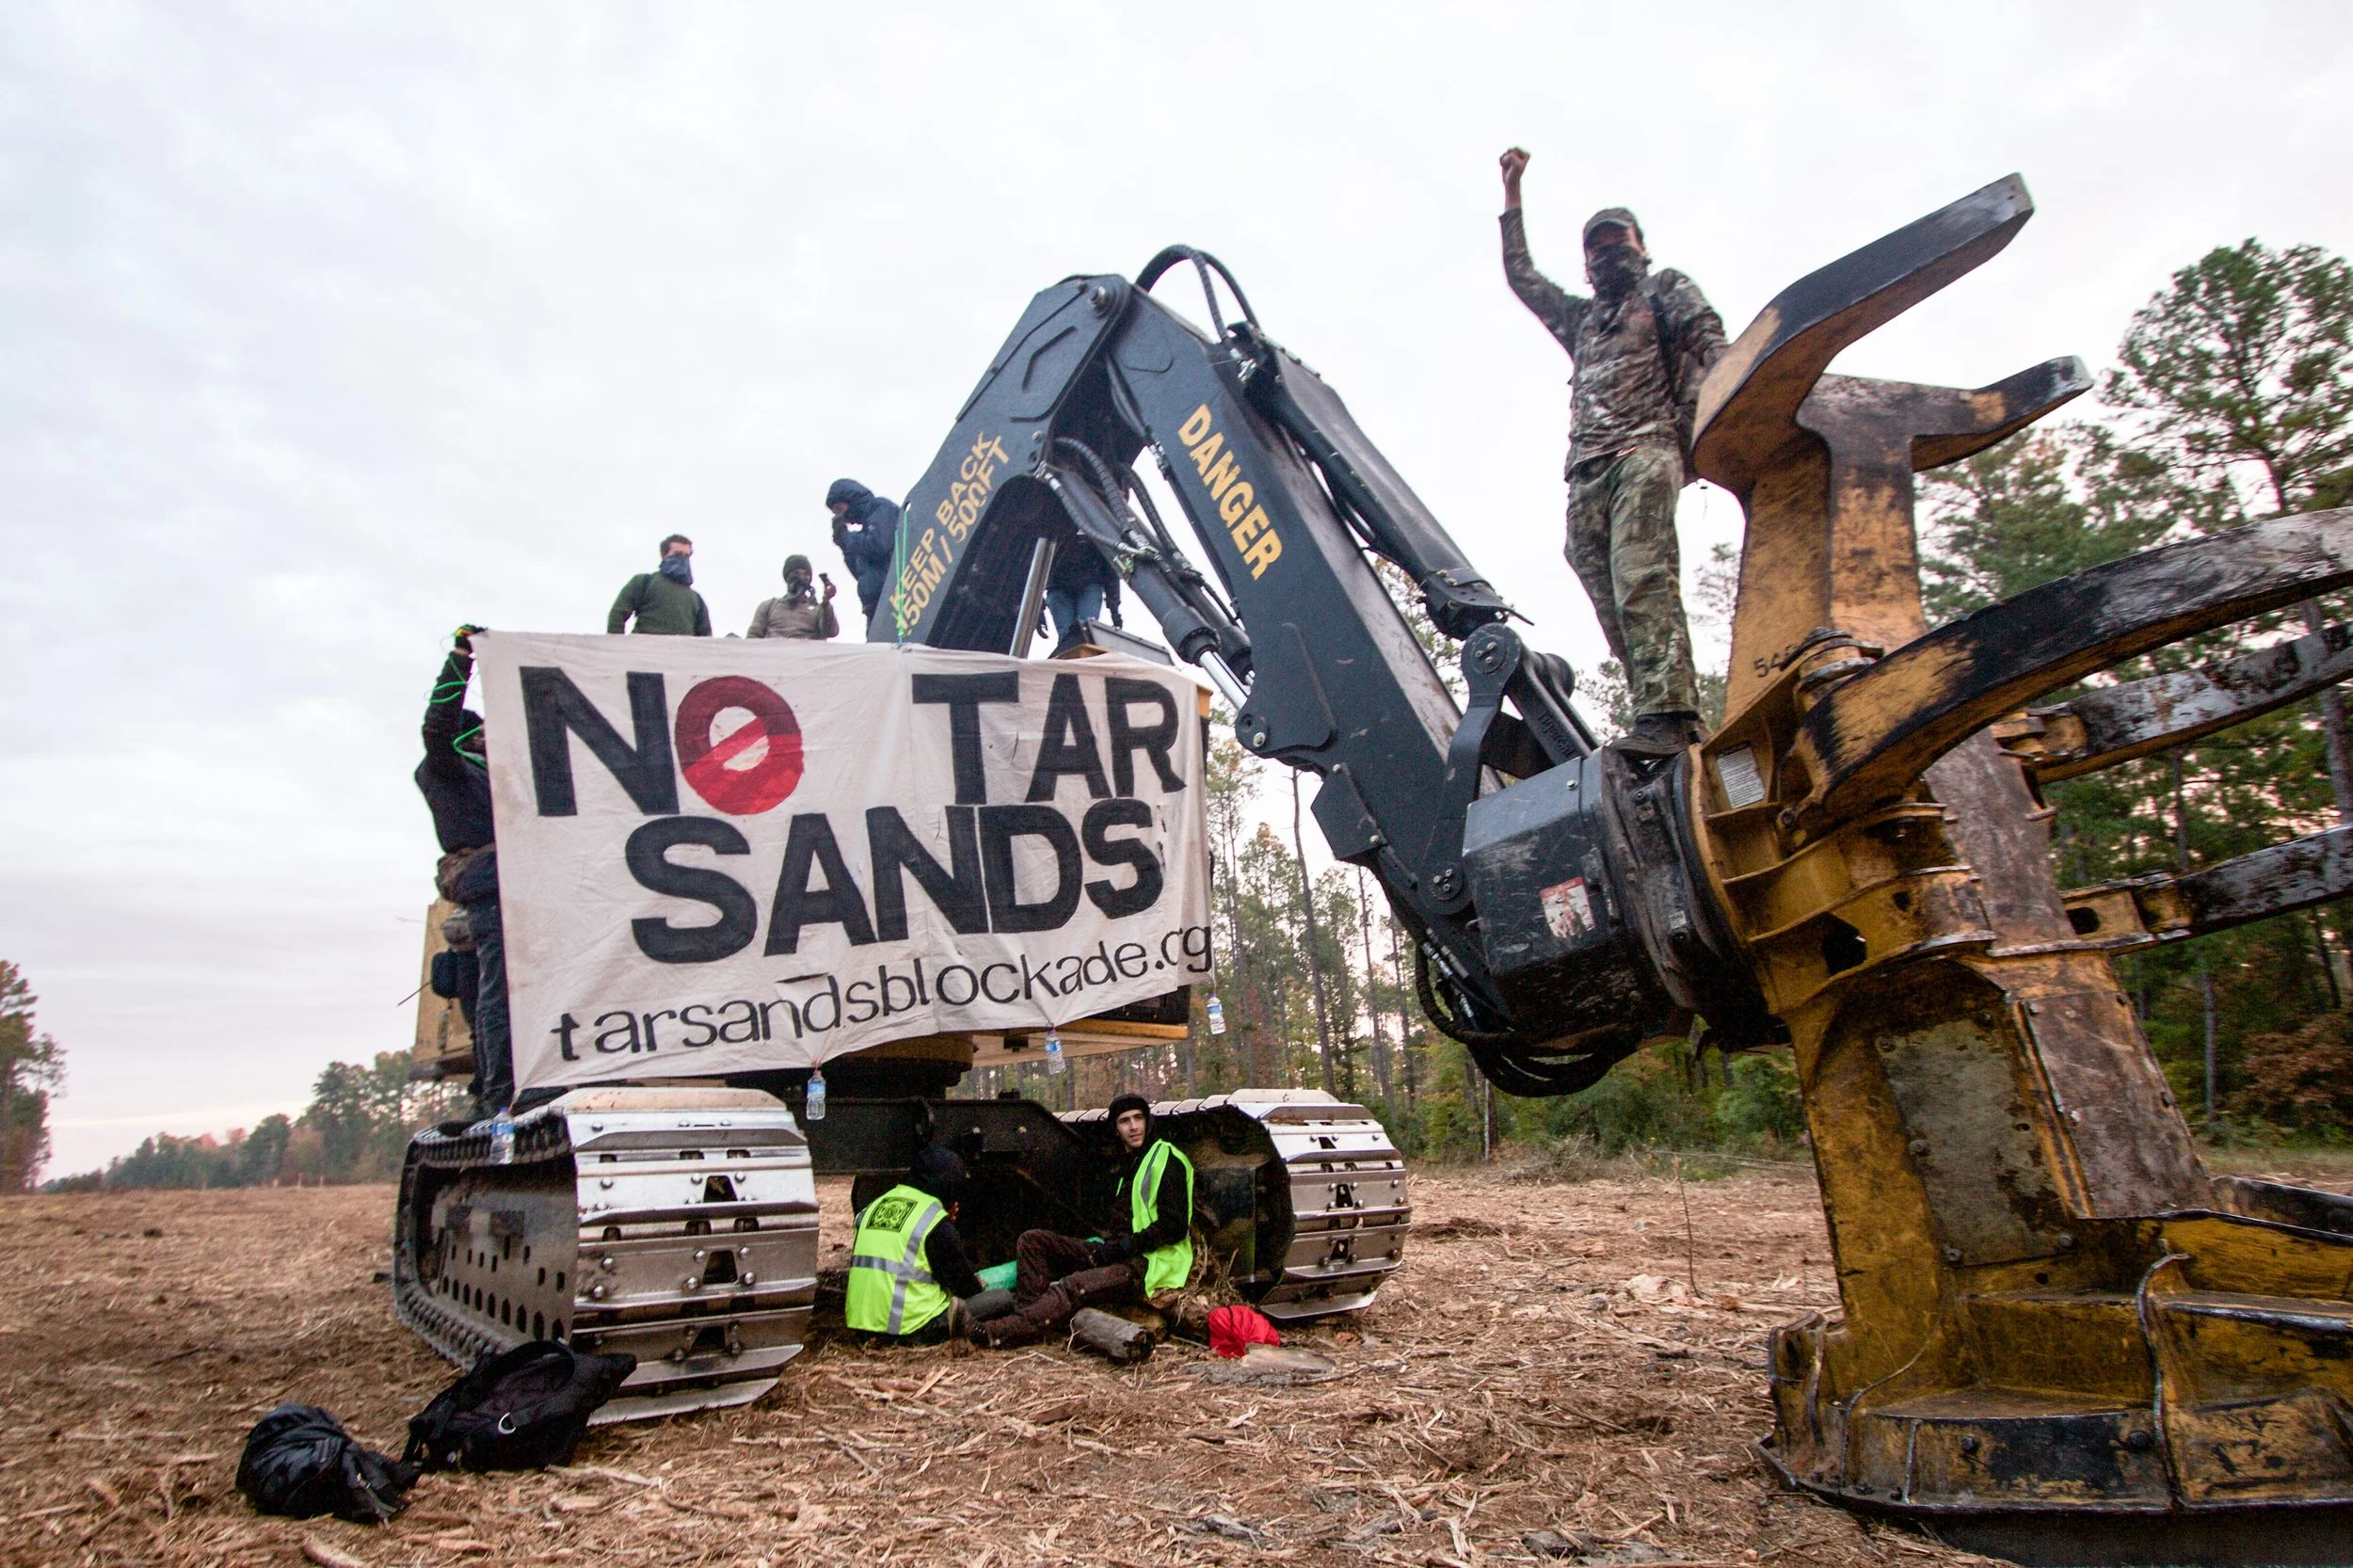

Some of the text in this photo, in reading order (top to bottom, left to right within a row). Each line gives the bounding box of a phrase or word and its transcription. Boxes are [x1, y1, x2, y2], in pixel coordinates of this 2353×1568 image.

[889, 430, 993, 612] KEEP BACK
[948, 436, 1009, 543] 500FT
[1178, 404, 1283, 580] DANGER
[520, 666, 1187, 816] NO TAR
[626, 796, 1164, 964] SANDS
